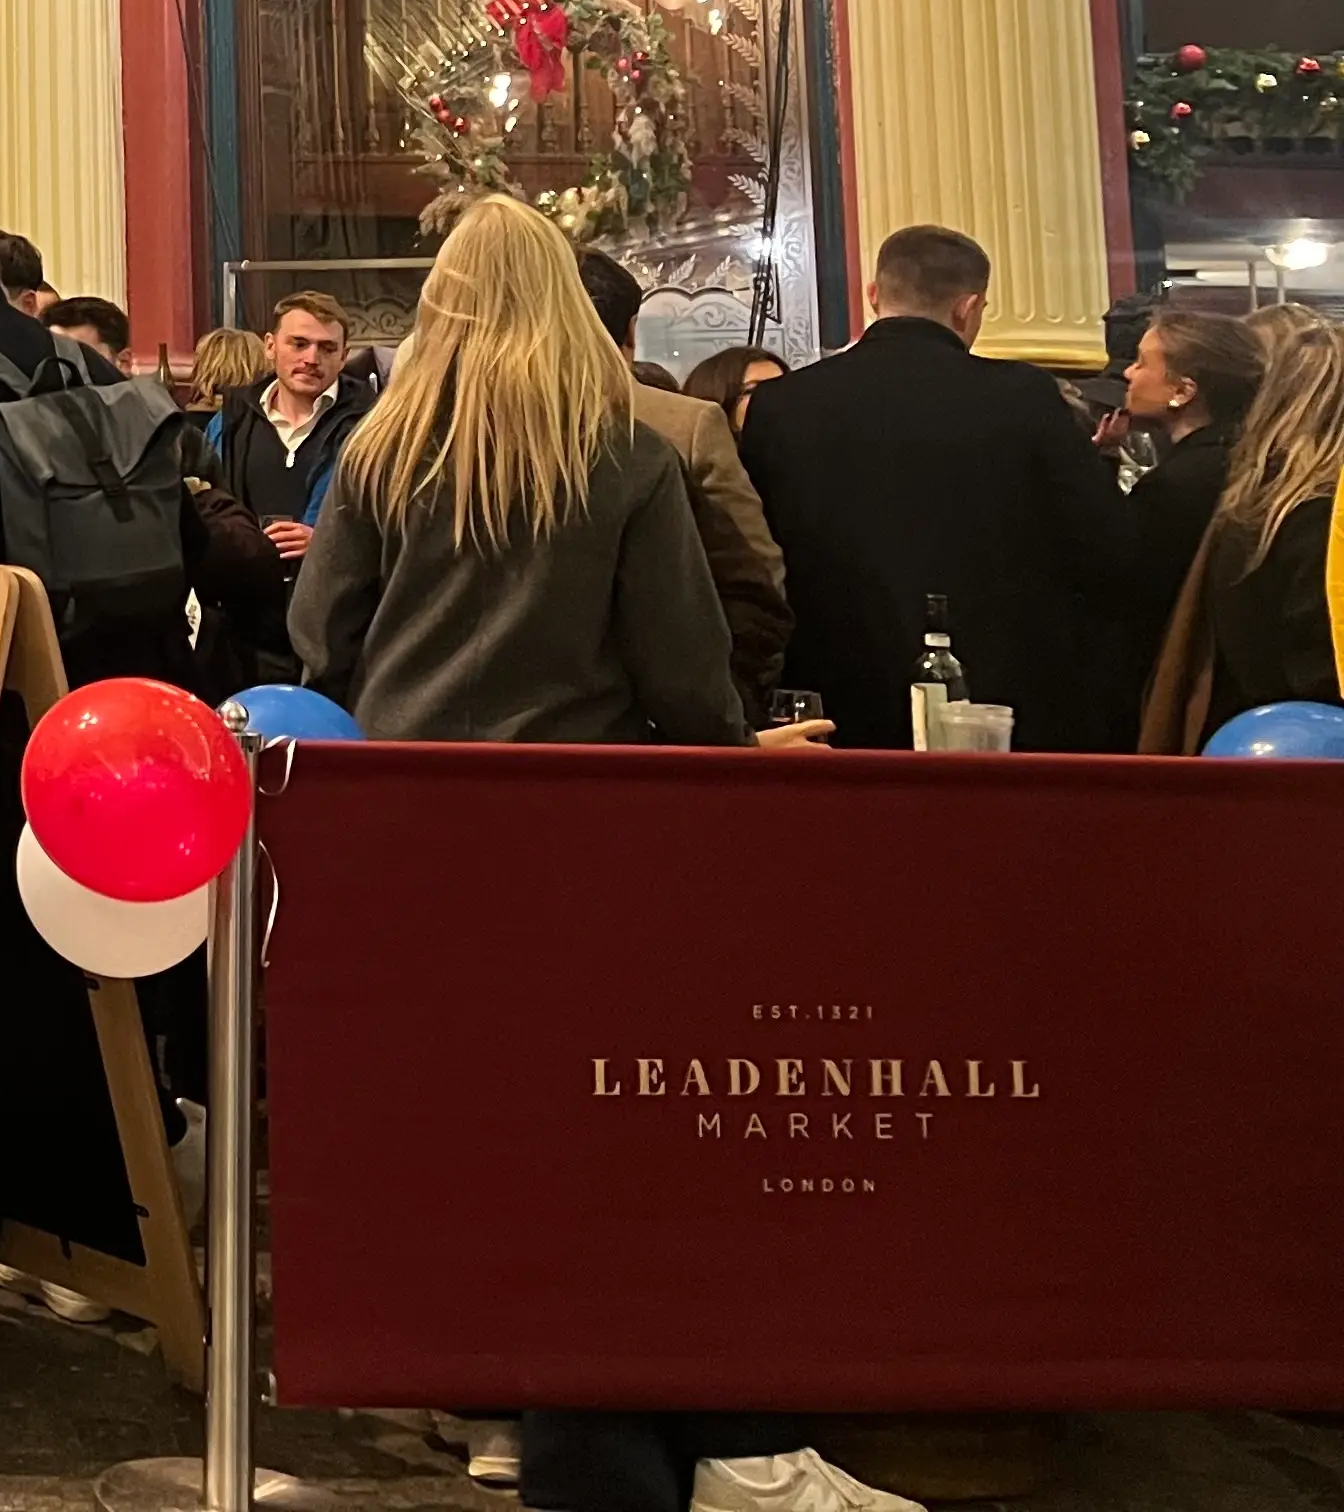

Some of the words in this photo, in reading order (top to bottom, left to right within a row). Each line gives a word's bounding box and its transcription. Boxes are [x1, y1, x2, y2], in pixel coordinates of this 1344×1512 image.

[590, 1057, 1042, 1099] LEADENHALL
[697, 1112, 936, 1140] MARKET
[762, 1178, 877, 1194] LONDON
